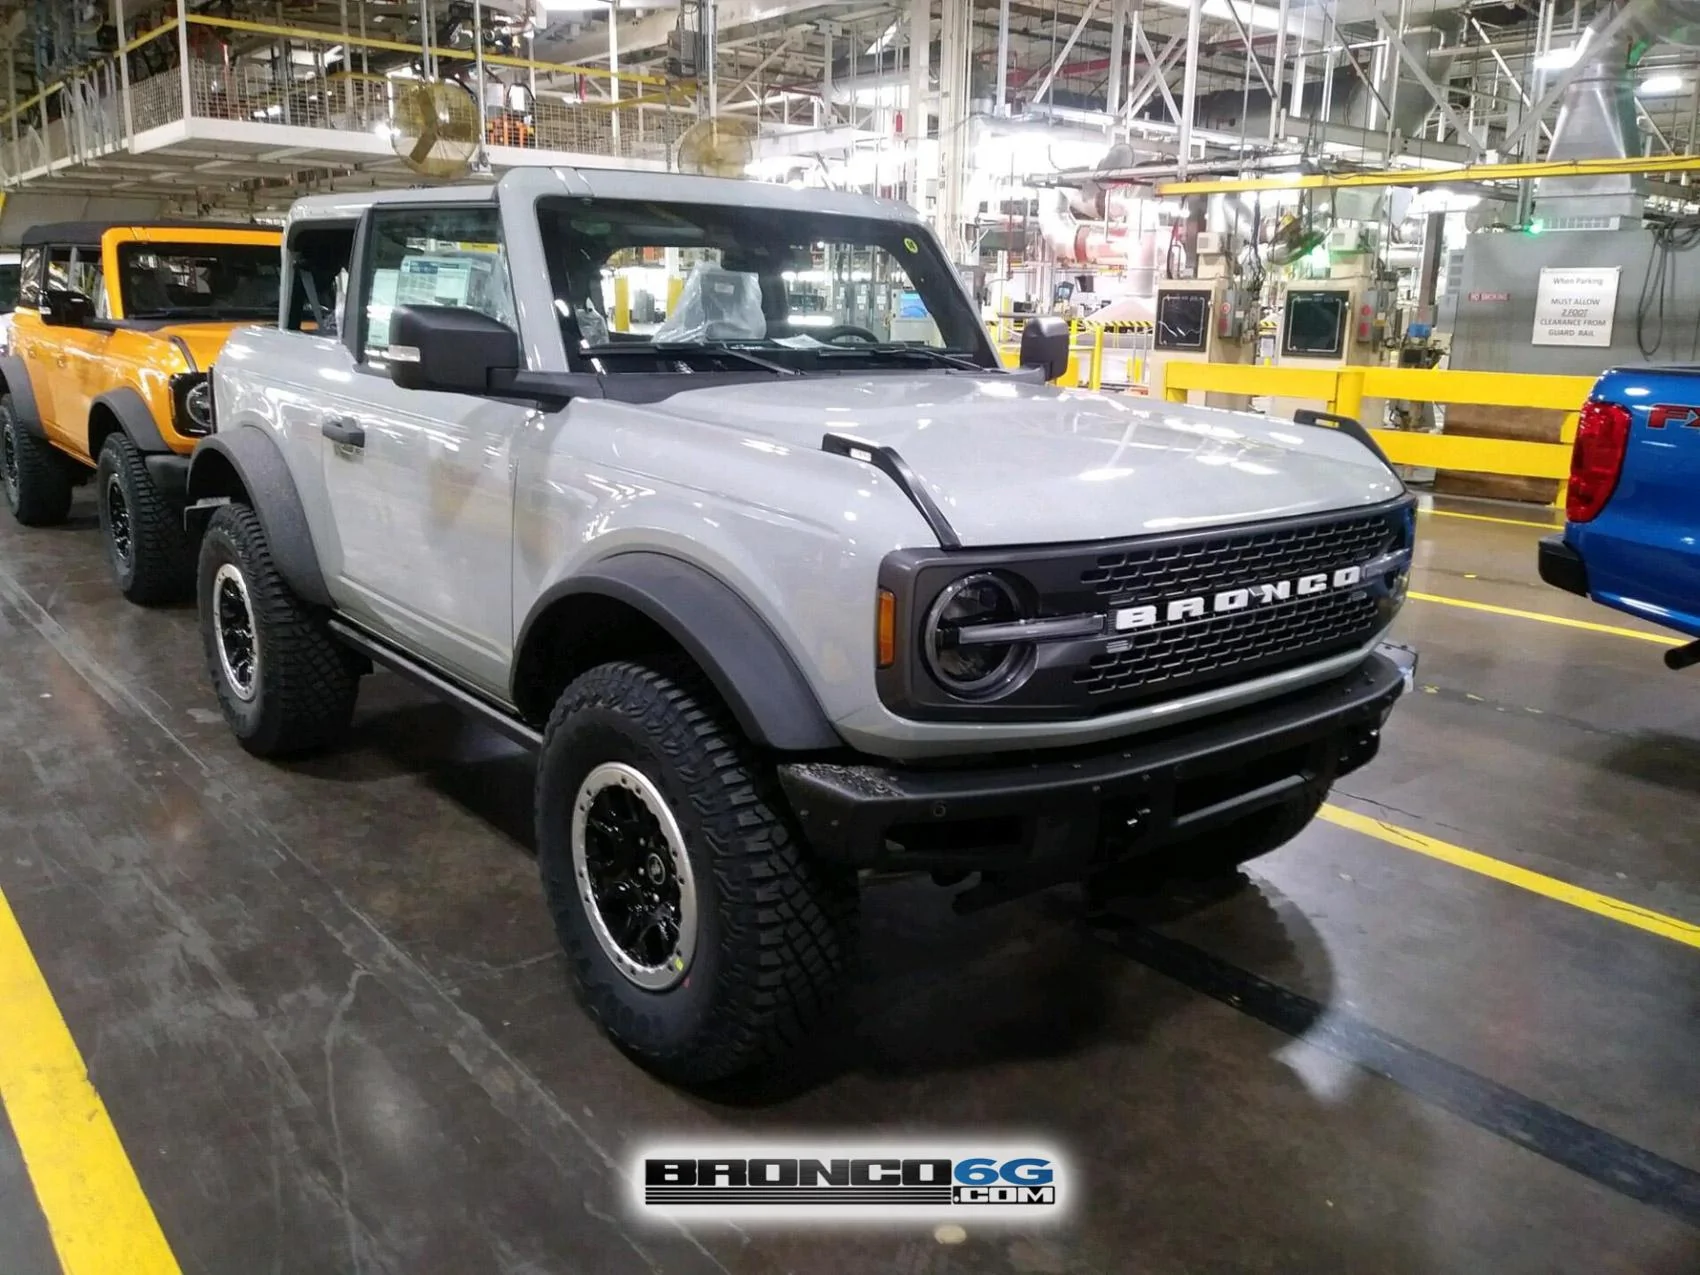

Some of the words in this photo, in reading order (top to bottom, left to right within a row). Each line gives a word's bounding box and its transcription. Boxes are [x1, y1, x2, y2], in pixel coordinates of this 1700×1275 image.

[1576, 278, 1603, 286] Parking
[1567, 309, 1588, 317] FOOT
[1540, 318, 1581, 326] CLEARANCE
[1582, 318, 1606, 326] FROM
[1548, 329, 1575, 337] GUARD
[1577, 329, 1595, 337] RAIL
[1115, 566, 1361, 631] BRONCO
